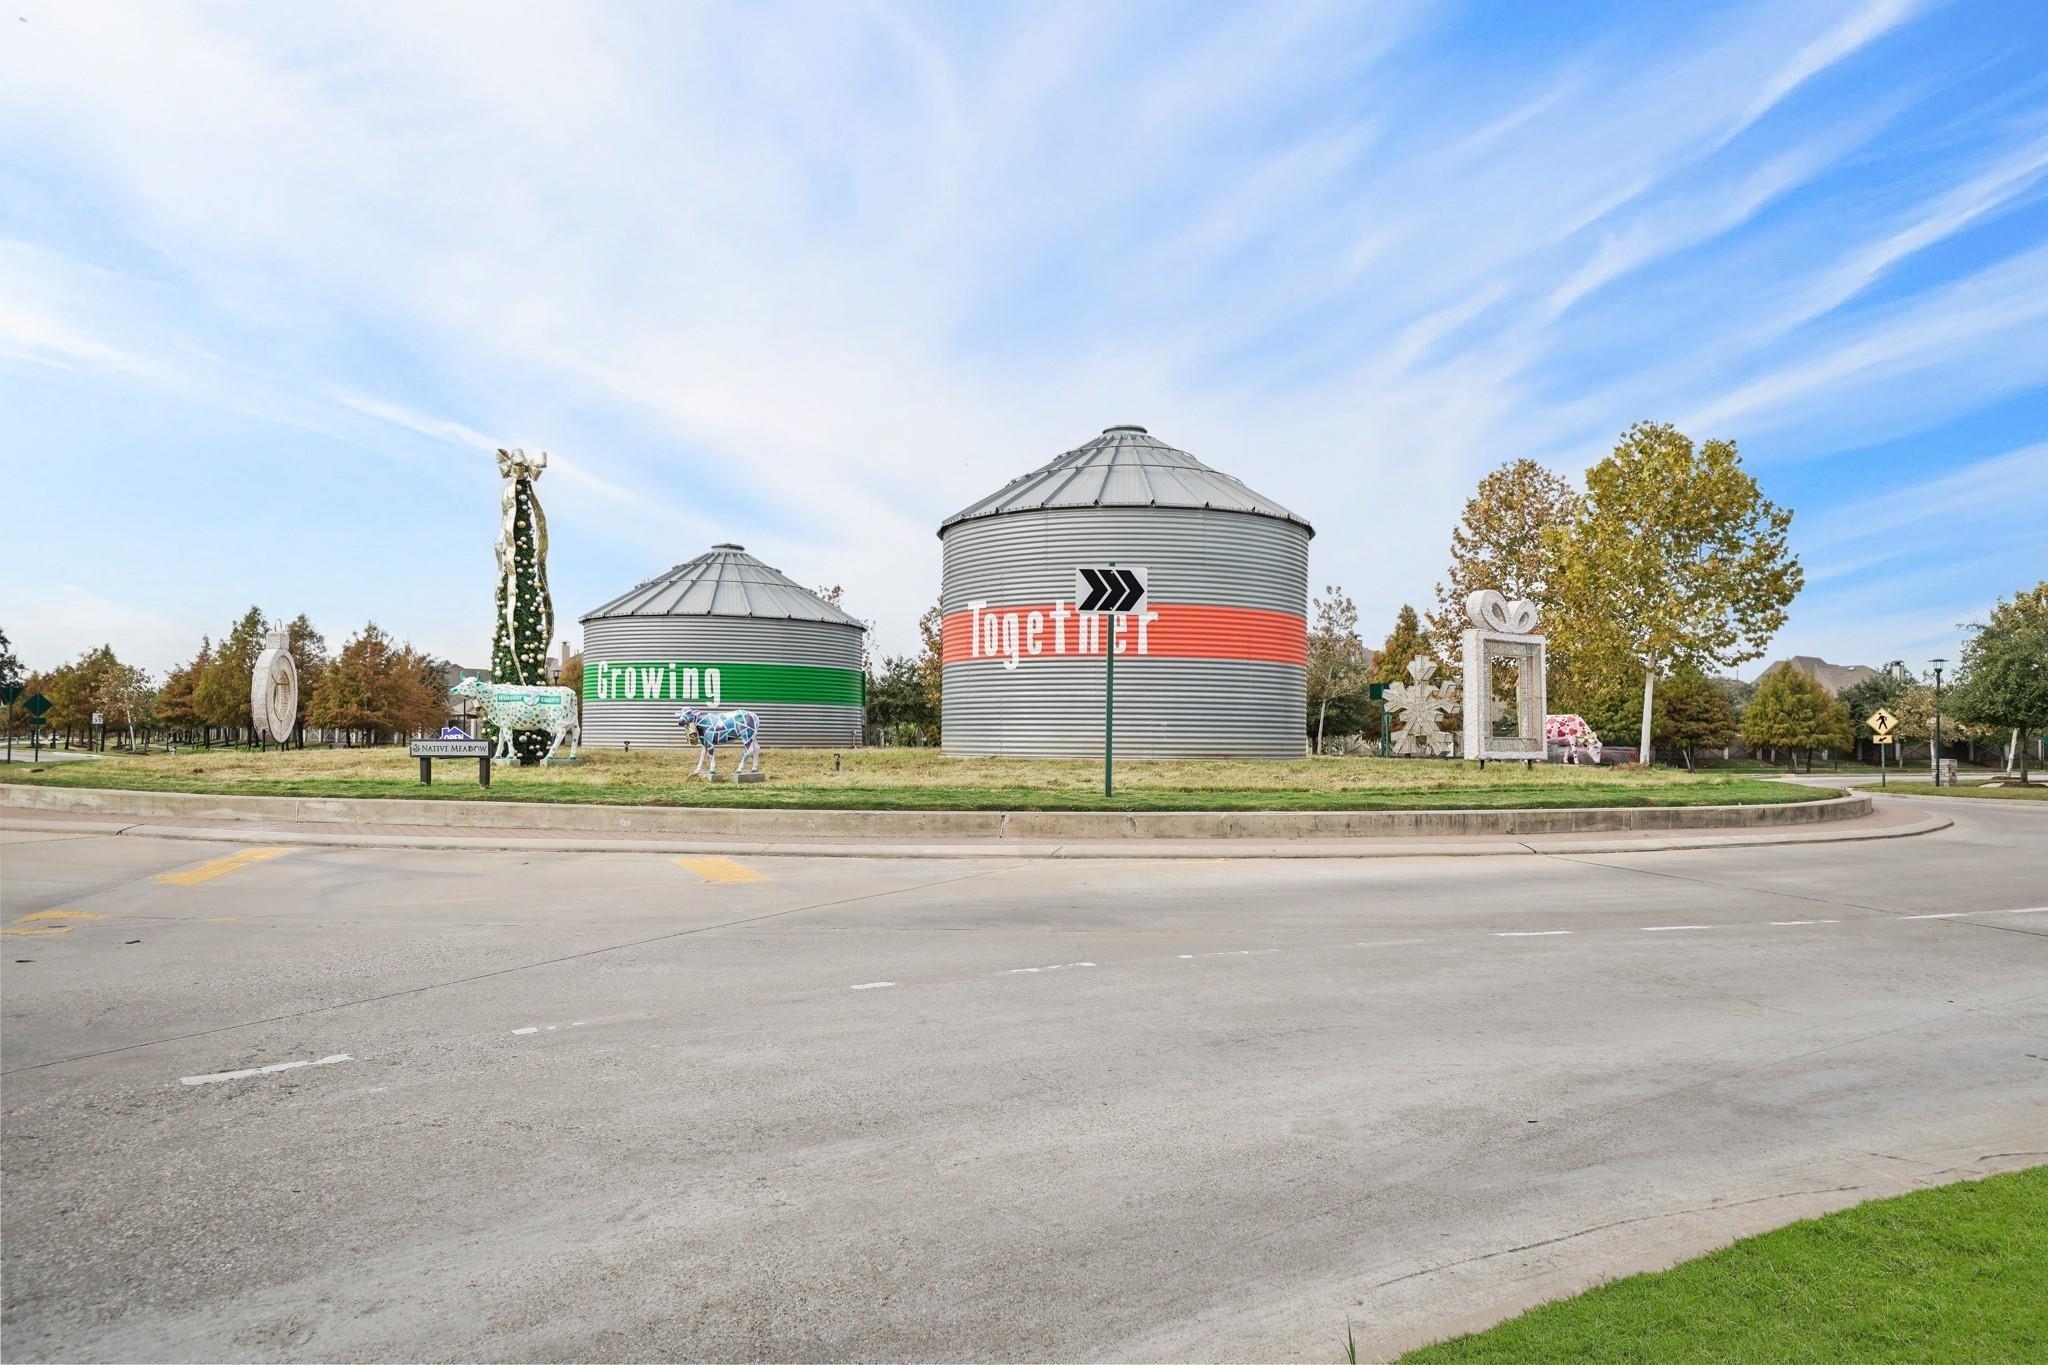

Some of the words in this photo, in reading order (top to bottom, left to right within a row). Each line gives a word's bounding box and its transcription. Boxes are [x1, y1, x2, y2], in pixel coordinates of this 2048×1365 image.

[968, 600, 1159, 670] Together
[597, 660, 721, 708] Growing
[421, 744, 449, 752] NATIVE
[451, 744, 487, 752] MEADOW
